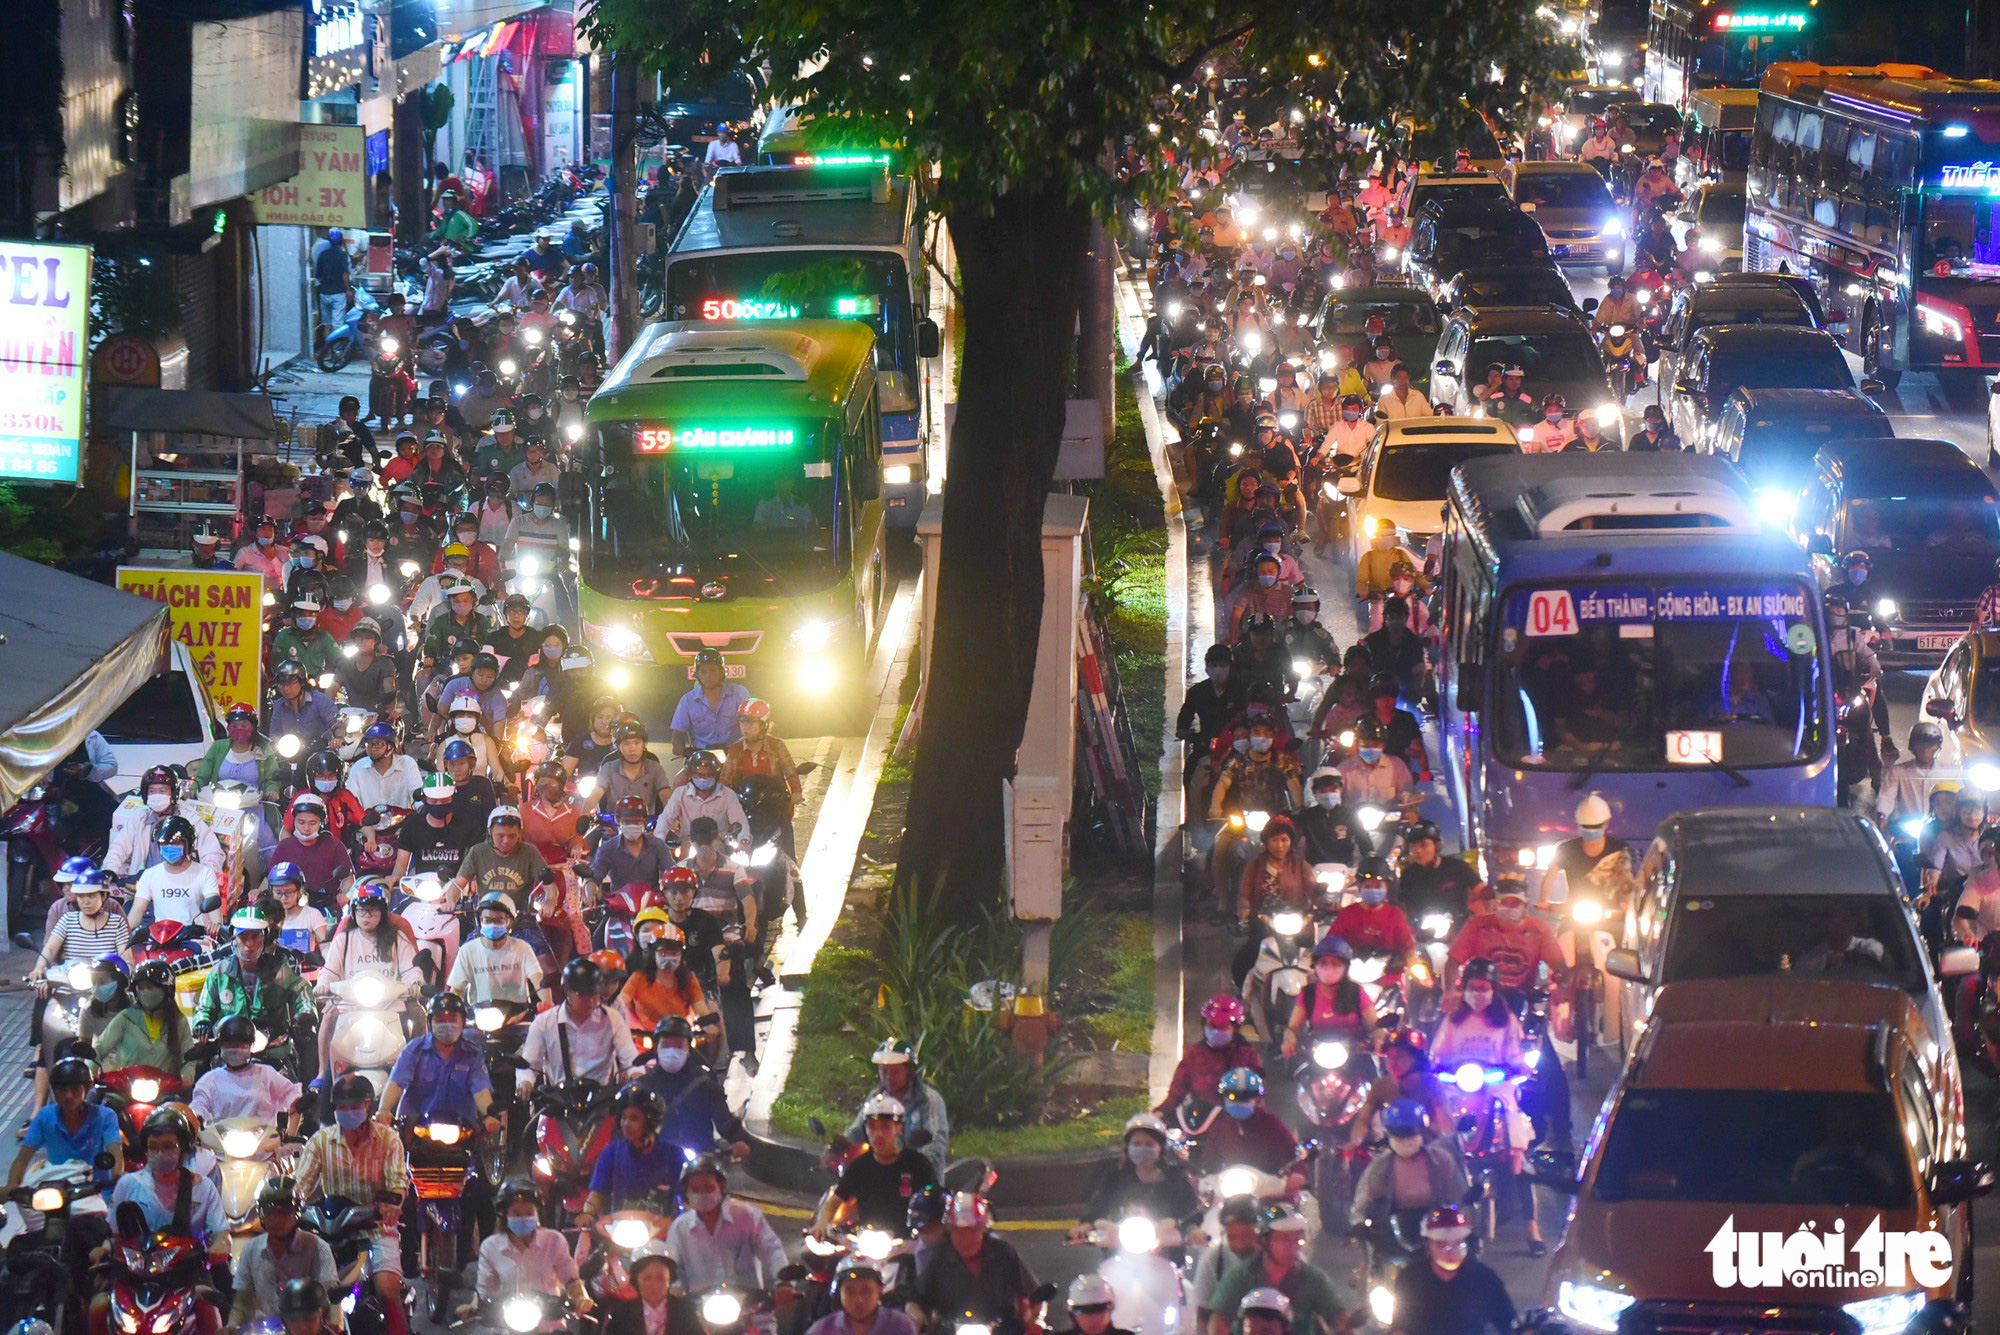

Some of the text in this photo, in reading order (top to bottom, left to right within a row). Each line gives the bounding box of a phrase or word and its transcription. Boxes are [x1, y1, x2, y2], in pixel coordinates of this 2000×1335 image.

[1936, 264, 1949, 274] 12
[642, 430, 671, 450] 59
[206, 584, 251, 615] SẠN
[1580, 591, 1605, 619] BẾN
[1607, 593, 1648, 618] THÀNH
[1657, 592, 1690, 620] CỘNG
[1693, 592, 1720, 617] HÒA
[1727, 597, 1744, 616] BX
[1745, 597, 1762, 616] AN
[1533, 596, 1570, 633] 04
[169, 621, 242, 647] ANH
[200, 650, 242, 687] ỀN
[161, 888, 190, 898] 199X
[357, 954, 381, 964] ACN
